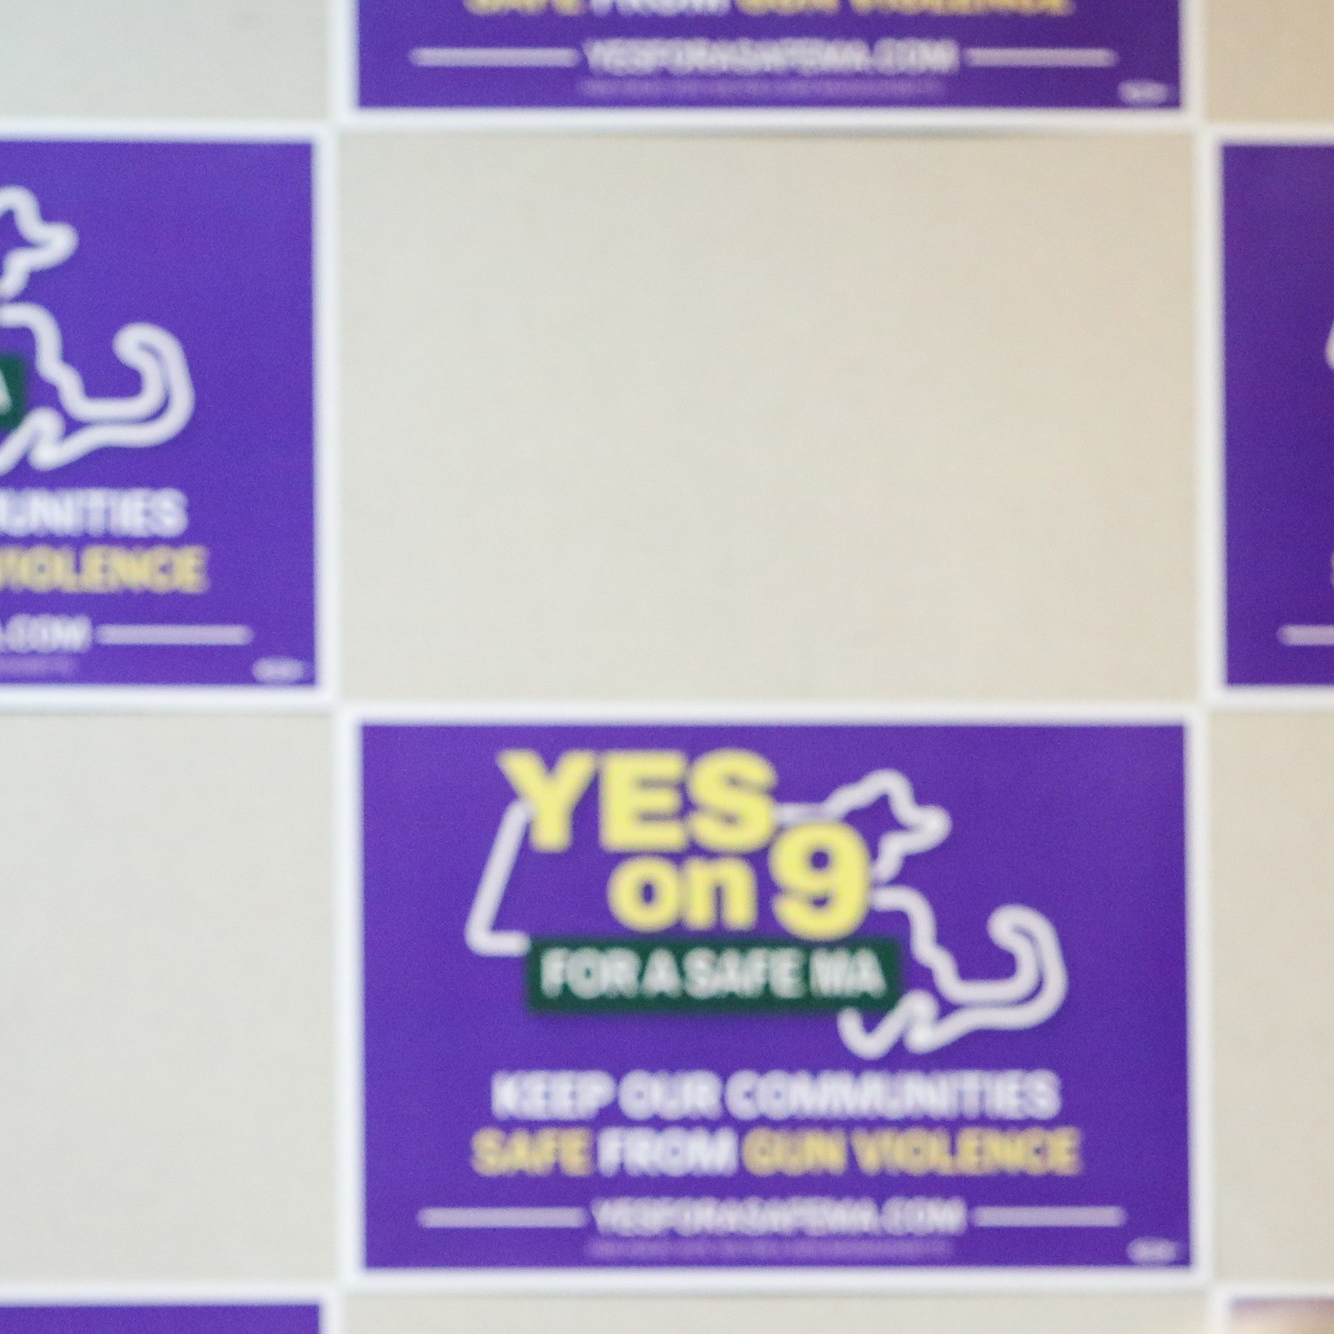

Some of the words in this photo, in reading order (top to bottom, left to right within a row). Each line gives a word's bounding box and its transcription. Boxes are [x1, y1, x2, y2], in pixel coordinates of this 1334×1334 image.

[497, 749, 776, 852] YES
[607, 856, 757, 931] on
[768, 820, 869, 939] 9
[540, 949, 642, 998] FOR
[643, 949, 683, 998] A
[685, 949, 804, 999] SAFE
[812, 949, 886, 999] MA
[491, 1071, 616, 1119] KEEP
[619, 1071, 722, 1119] OUR
[724, 1071, 1061, 1121] COMMUNITIES
[472, 1128, 593, 1176] SAFE
[597, 1128, 738, 1176] FROM
[742, 1128, 848, 1176] GUN
[852, 1128, 1081, 1176] VIOLENCE
